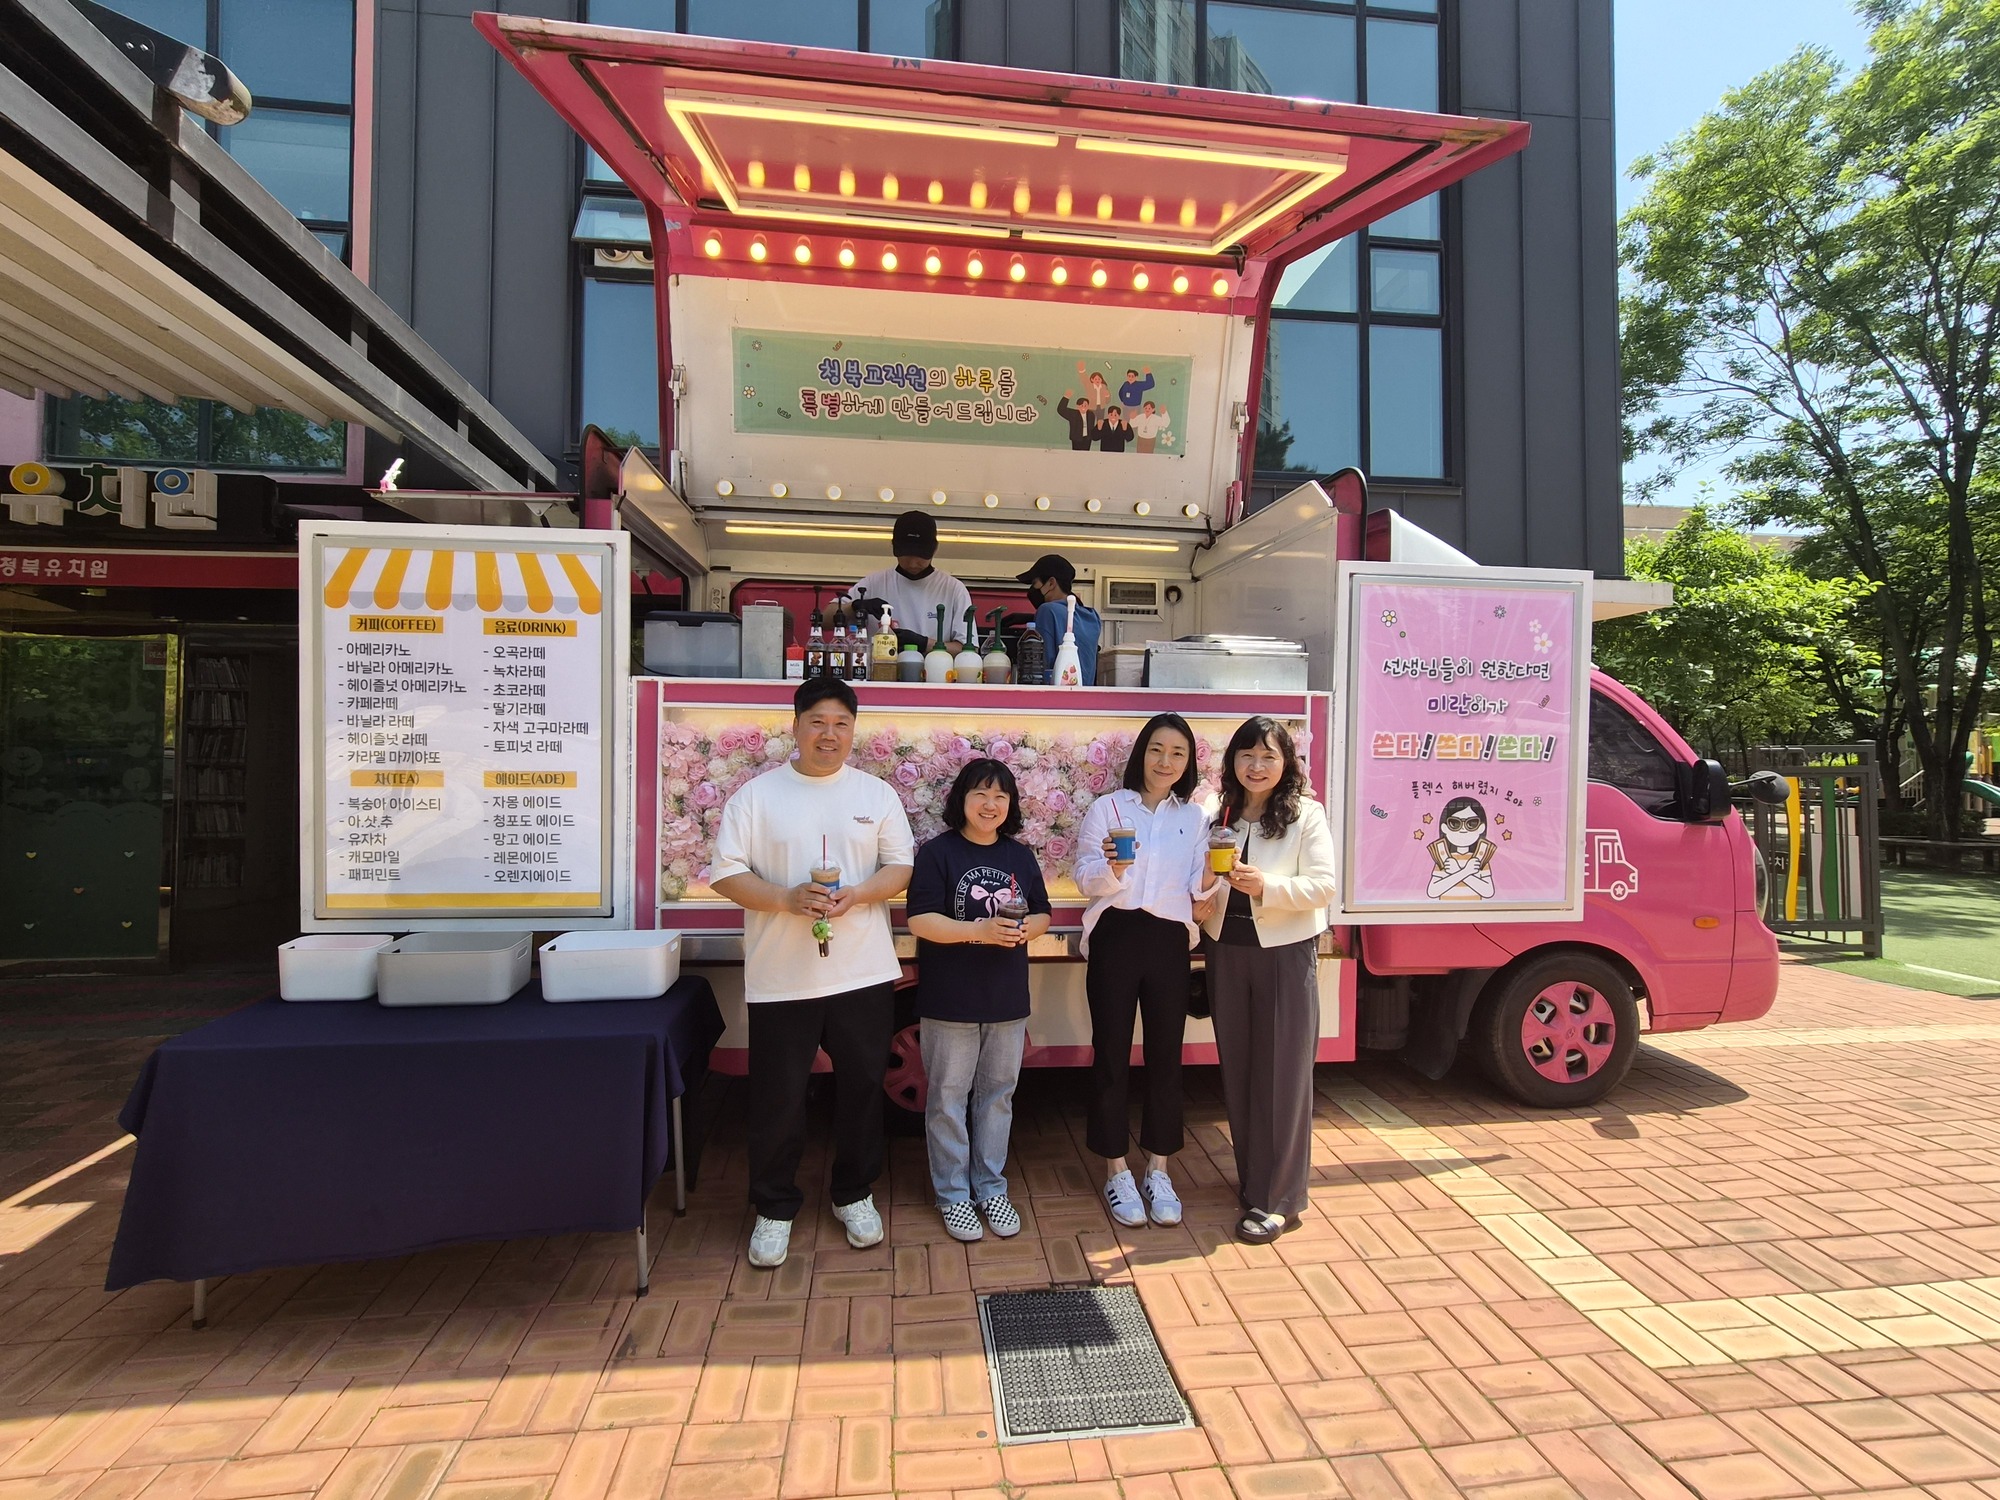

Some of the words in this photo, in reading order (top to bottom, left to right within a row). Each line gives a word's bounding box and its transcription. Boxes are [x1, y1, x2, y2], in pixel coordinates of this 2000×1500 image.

[818, 357, 947, 392] 청북교직원의
[954, 366, 1015, 398] 하루를
[801, 388, 885, 418] 특별하게
[891, 396, 1037, 424] 만들어드립니다
[0, 461, 218, 531] 유치원
[0, 556, 109, 579] 청북유치원
[356, 617, 436, 632] 커피(COFFEE)
[494, 620, 567, 635] 음료(DRINK)
[347, 643, 411, 656] 아메리카노
[493, 646, 545, 660] 오곡라떼
[347, 661, 385, 674] 바닐라
[389, 661, 454, 675] 아메리카노
[493, 665, 545, 678] 녹차라떼
[1383, 656, 1473, 682] 선생님들이
[1480, 660, 1551, 680] 원한다면
[347, 678, 398, 692] 헤이즐넛
[401, 679, 467, 693] 아메리카노
[493, 683, 545, 697] 초코라떼
[347, 697, 398, 710] 카페라떼
[493, 702, 545, 716] 딸기라떼
[1428, 693, 1508, 715] 미란이가
[347, 714, 386, 728] 바닐라
[389, 715, 414, 728] 라떼
[493, 721, 519, 735] 자색
[523, 722, 588, 735] 고구마라떼
[347, 732, 398, 746] 헤이즐넛
[402, 733, 427, 746] 라떼
[493, 740, 532, 753] 토피넛
[537, 740, 562, 753] 라떼
[1372, 732, 1434, 759] 쏜다!
[1435, 734, 1495, 760] 쏜다!
[1497, 735, 1556, 761] 쏜다!
[348, 750, 386, 764] 카라멜
[389, 750, 441, 764] 마끼야또
[375, 773, 419, 786] 차(TEA)
[495, 773, 565, 786] 에이드(ADE)
[1411, 781, 1443, 799] 플렉스
[1452, 780, 1498, 796] 해버렸지
[1504, 790, 1523, 807] 모야
[348, 798, 387, 812] 복숭아
[390, 798, 440, 811] 아이스티
[493, 796, 519, 809] 자몽
[523, 796, 562, 809] 에이드
[348, 815, 393, 830] 아.샷.추
[493, 814, 532, 827] 청포도
[536, 814, 575, 827] 에이드
[348, 833, 387, 846] 유자차
[493, 833, 519, 846] 망고
[523, 833, 562, 846] 에이드
[349, 851, 399, 864] 캐모마일
[494, 851, 558, 864] 레몬에이드
[349, 868, 401, 881] 패퍼민트
[494, 870, 571, 882] 오렌지에이드
[967, 869, 982, 881] MA
[981, 868, 1011, 885] PETITE
